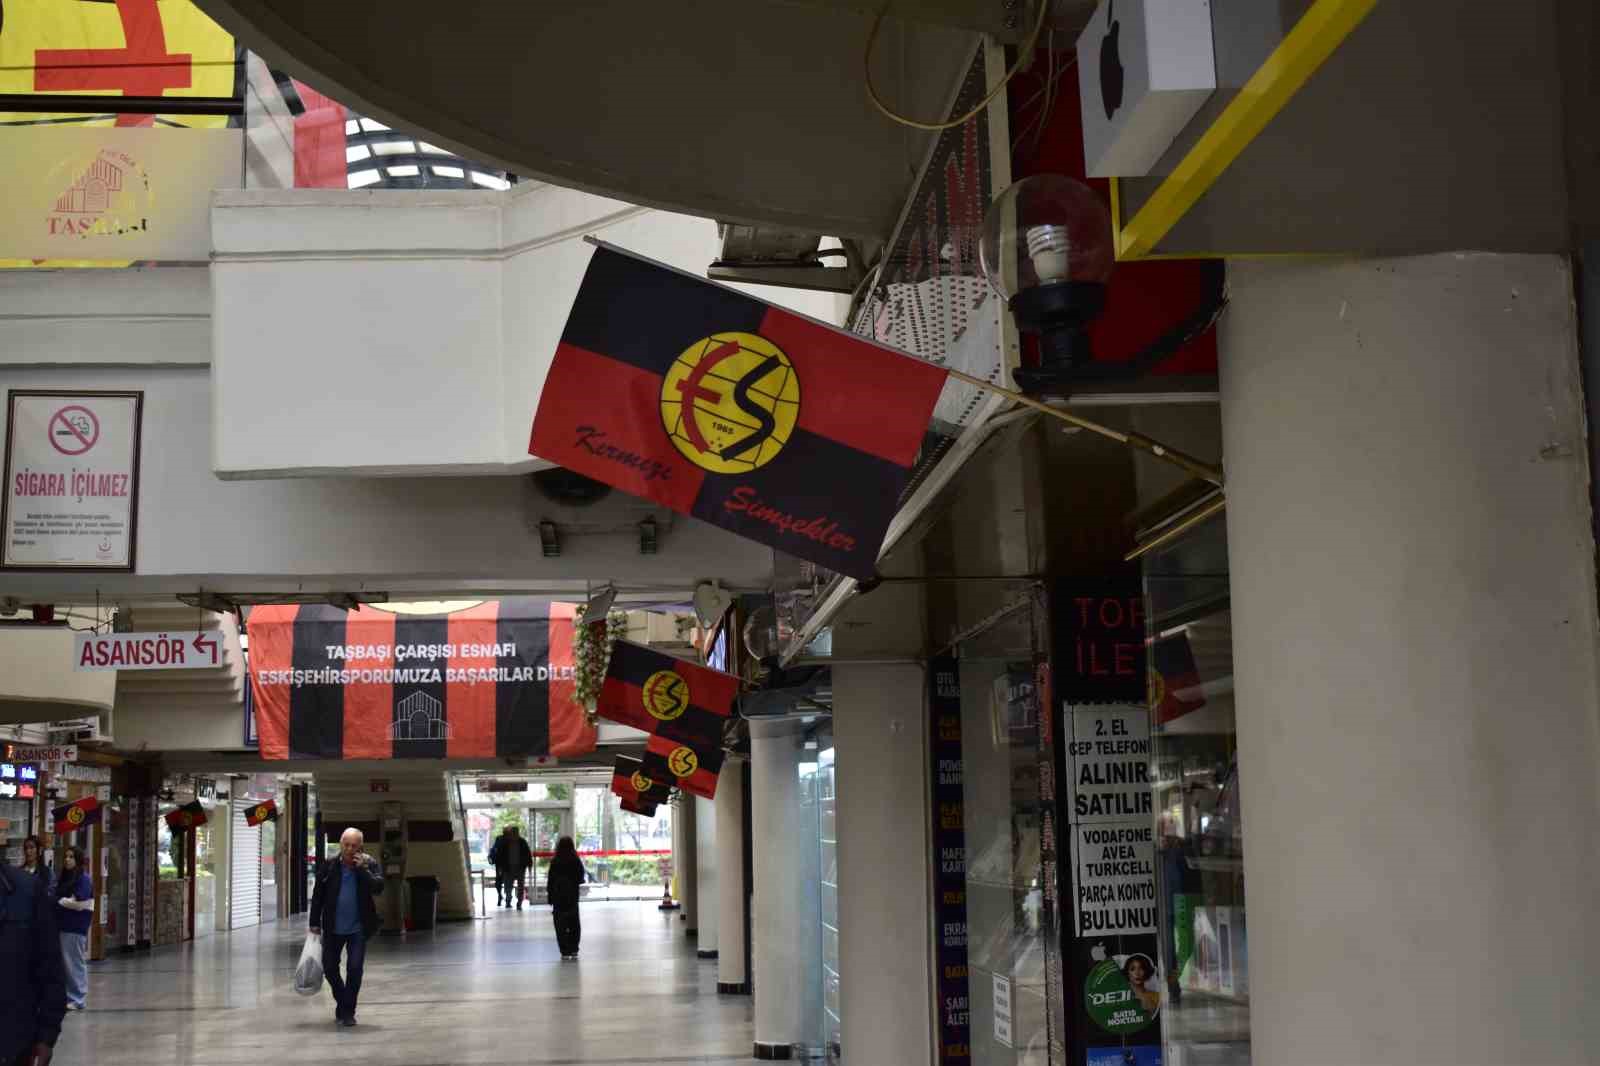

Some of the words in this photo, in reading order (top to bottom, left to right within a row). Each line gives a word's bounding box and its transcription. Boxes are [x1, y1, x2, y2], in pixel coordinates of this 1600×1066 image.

[15, 467, 66, 497] SİGARA
[71, 468, 129, 503] İÇİLMEZ
[80, 634, 185, 667] ASANSÖR
[325, 644, 391, 662] TAŞBAŞI
[395, 643, 457, 662] ÇARŞISI
[461, 642, 516, 658] ESNAFI
[257, 666, 442, 688] ESKİŞEHİRSPORUMUZA
[446, 666, 533, 686] BAŞARILAR
[1095, 720, 1107, 736] 2.
[1111, 719, 1129, 735] EL
[1080, 762, 1149, 785] ALINIR
[1075, 792, 1152, 816] SATILIR
[1083, 829, 1152, 844] VODAFONE
[1102, 846, 1136, 860] AVEA
[1086, 862, 1153, 877] TURKCELL
[1080, 884, 1115, 905] PARÇA
